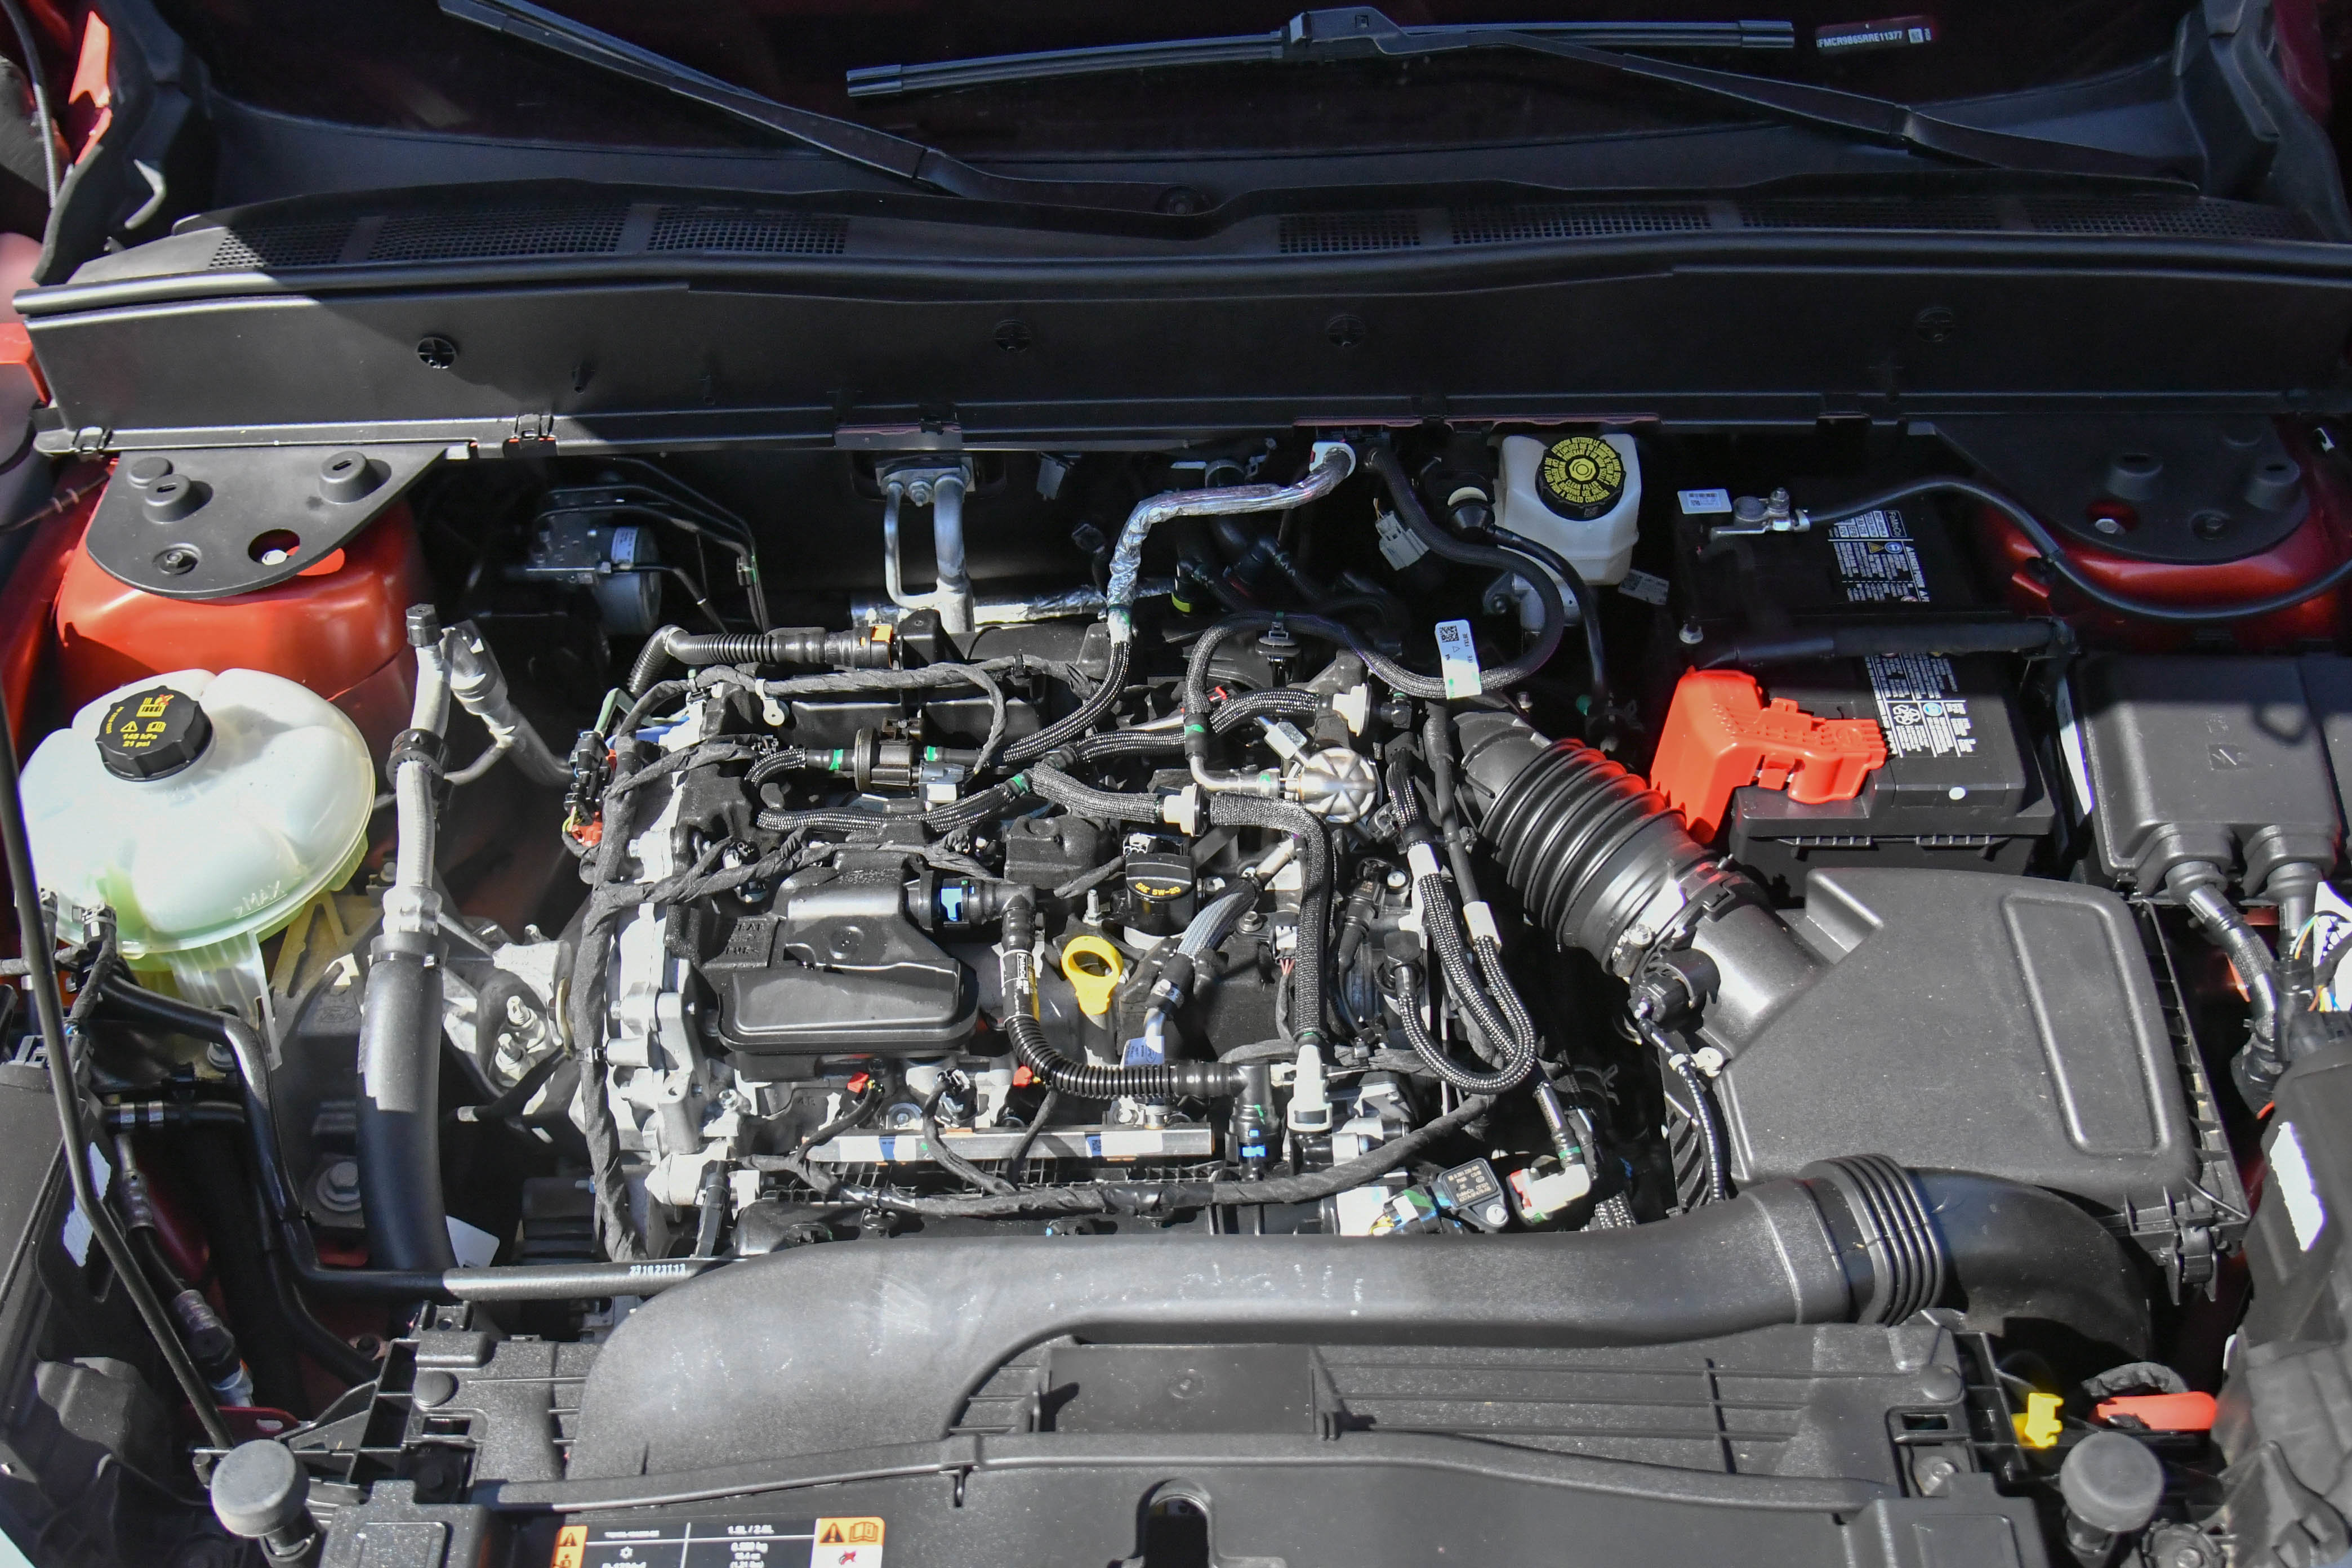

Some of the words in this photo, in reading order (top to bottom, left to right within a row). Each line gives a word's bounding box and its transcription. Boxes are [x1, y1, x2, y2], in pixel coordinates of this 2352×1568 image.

[1544, 470, 1554, 483] FLUID
[1549, 482, 1562, 494] FROM
[1565, 493, 1583, 503] SEALED
[1585, 489, 1610, 503] CONTAINER
[1558, 482, 1580, 496] REMOVING
[1592, 486, 1603, 496] ONLY
[1566, 479, 1581, 489] CLEAN
[1583, 481, 1603, 491] FILLER
[1888, 511, 1901, 536] FoMoCo
[241, 880, 284, 911] MAX
[1135, 882, 1150, 893] SAE
[1152, 886, 1181, 896] 5W-20
